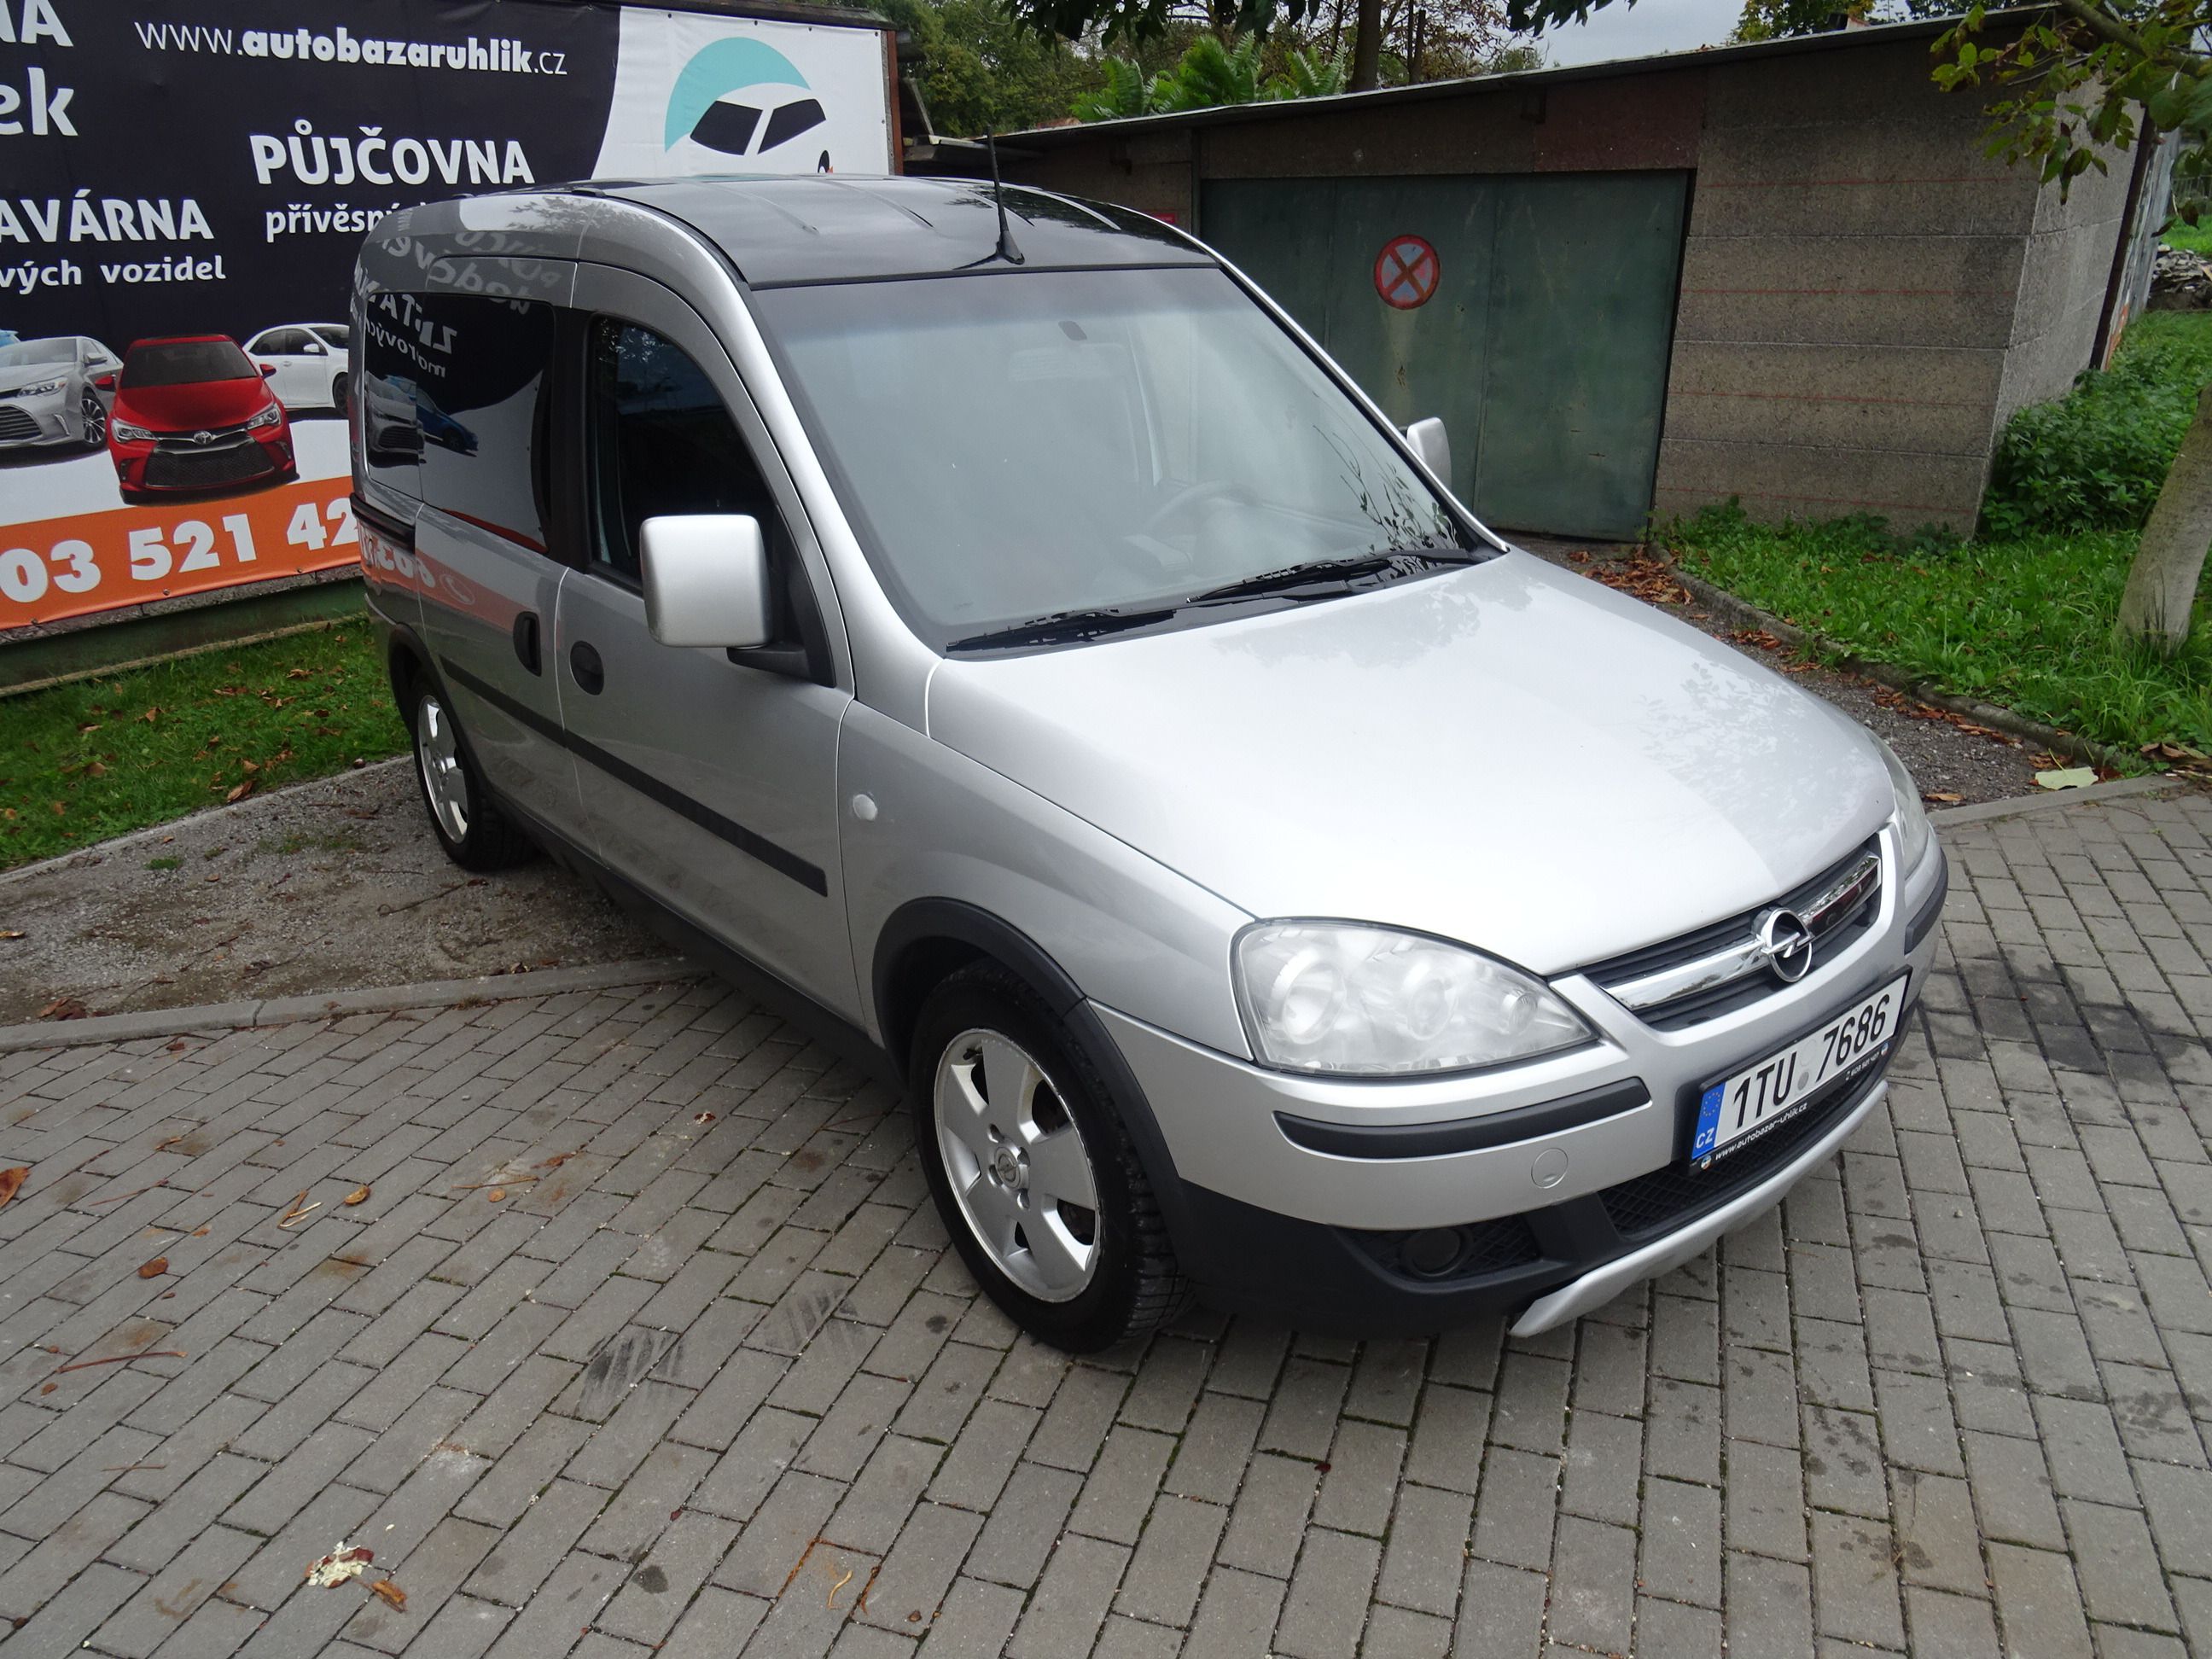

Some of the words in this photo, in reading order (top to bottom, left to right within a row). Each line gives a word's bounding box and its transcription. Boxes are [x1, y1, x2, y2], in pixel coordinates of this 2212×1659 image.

[134, 21, 568, 76] www.autobazaruhlik.cz
[249, 119, 536, 185] PŮJČOVNA
[100, 255, 226, 283] vozidel
[0, 539, 102, 602] 03
[128, 513, 257, 582] 521
[1733, 1051, 1797, 1129] 1TU
[1816, 993, 1890, 1083] 7686
[1695, 1126, 1714, 1149] CZ
